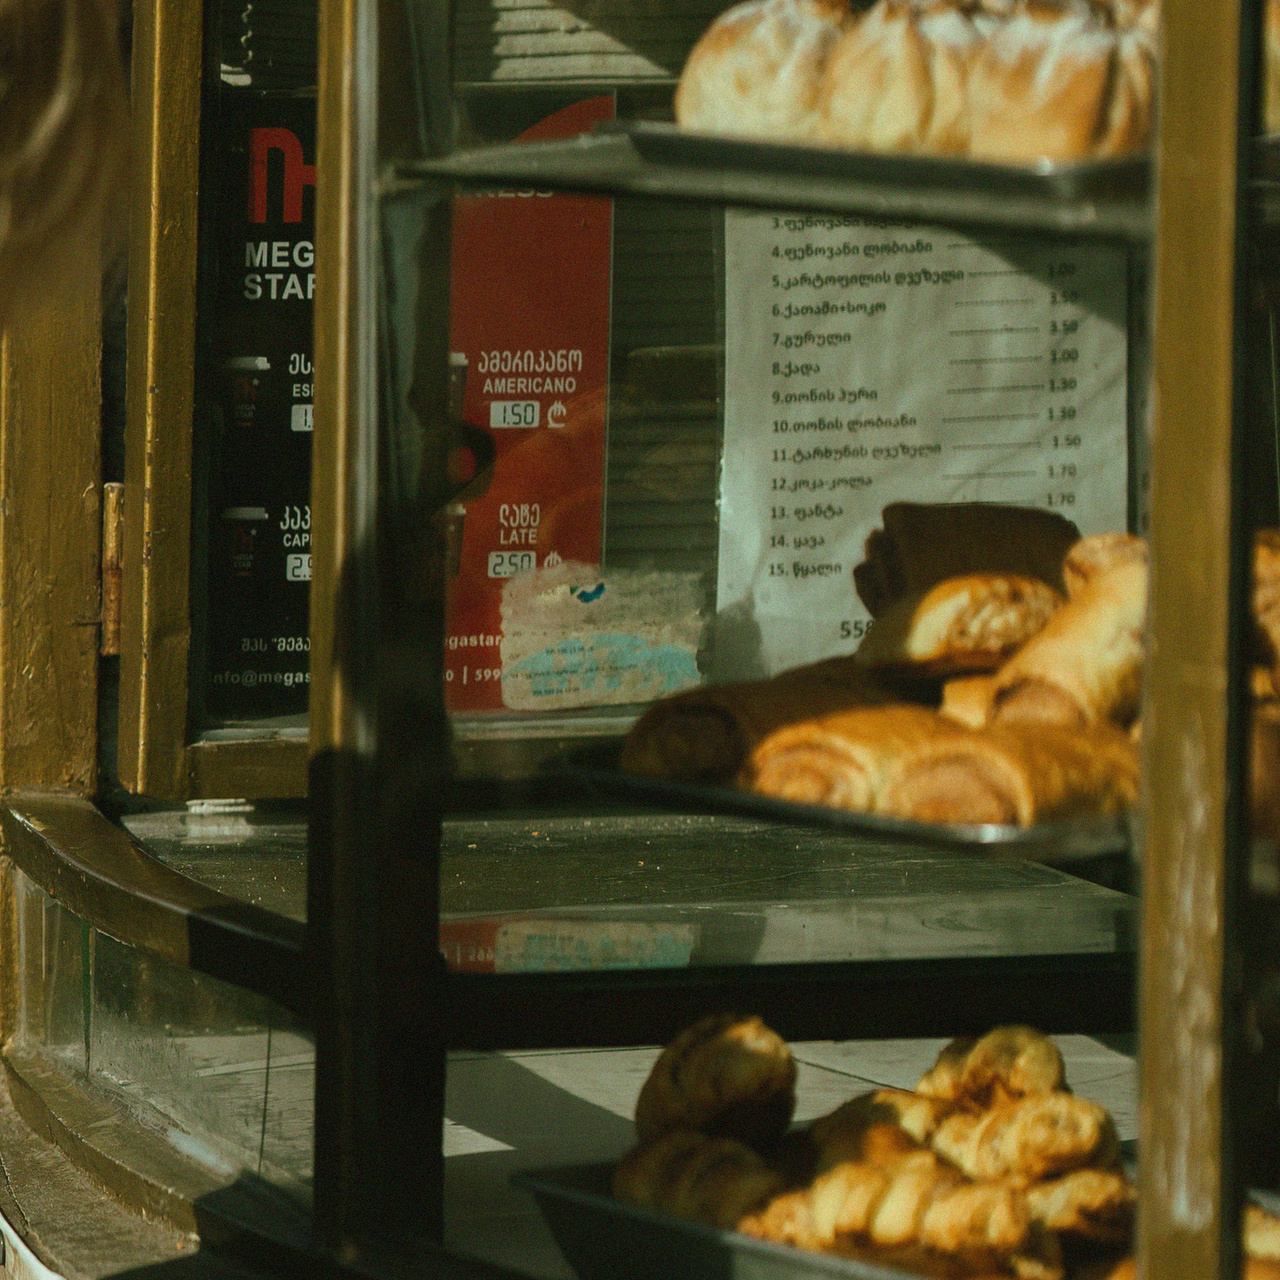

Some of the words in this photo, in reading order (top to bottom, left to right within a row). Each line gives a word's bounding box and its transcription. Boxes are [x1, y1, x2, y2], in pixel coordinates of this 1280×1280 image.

[478, 350, 583, 373] ამერიკანო
[483, 377, 577, 394] AMERICANO
[501, 403, 535, 425] 1.50
[499, 502, 541, 528] ლატე
[500, 528, 538, 545] LATE
[493, 553, 532, 576] 2.50
